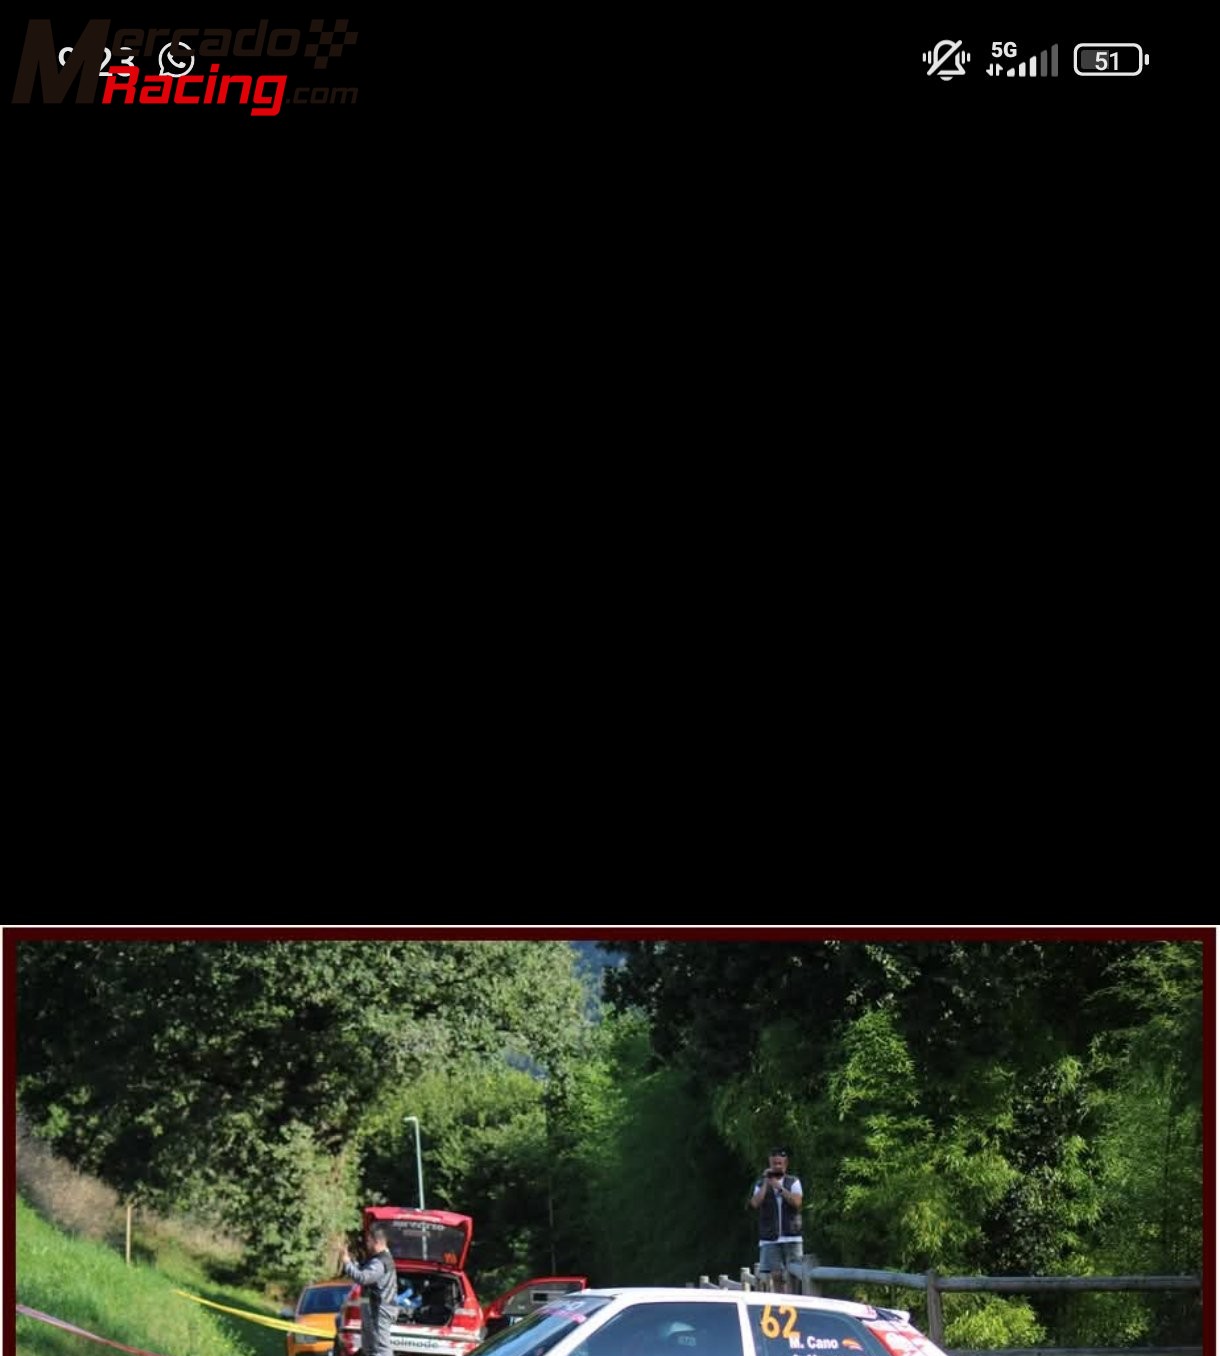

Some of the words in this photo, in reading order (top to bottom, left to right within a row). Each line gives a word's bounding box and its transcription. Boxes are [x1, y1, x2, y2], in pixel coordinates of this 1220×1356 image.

[991, 42, 1018, 58] 5G
[1095, 51, 1119, 71] 51
[761, 1301, 800, 1338] 62
[806, 1336, 839, 1349] Cano
